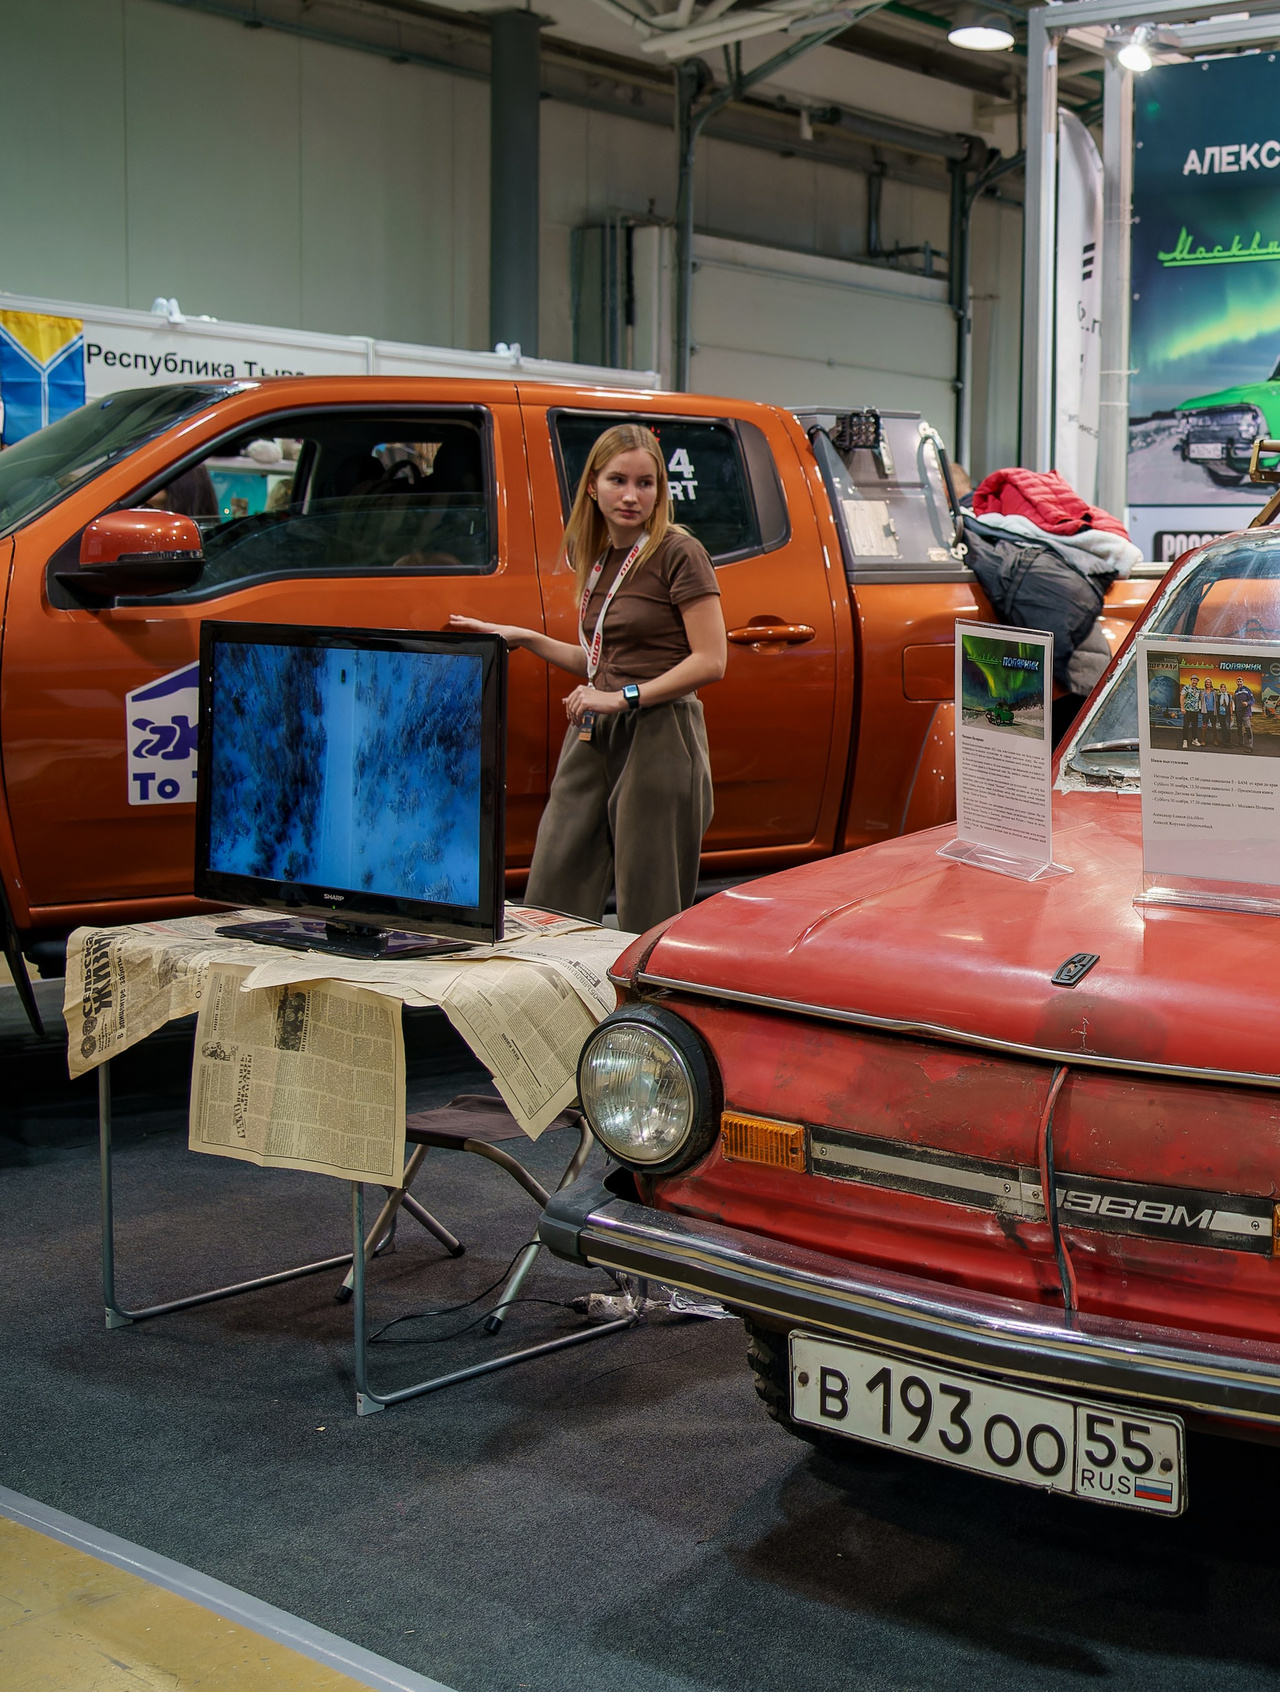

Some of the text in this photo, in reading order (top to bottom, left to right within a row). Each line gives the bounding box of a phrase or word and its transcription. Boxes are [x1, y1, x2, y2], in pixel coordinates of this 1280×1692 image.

[86, 342, 306, 381] Республика Ты
[323, 893, 345, 901] SHARP
[92, 934, 112, 1015] ЖИЗН
[1084, 1413, 1155, 1475] 55
[1081, 1468, 1132, 1495] RUS
